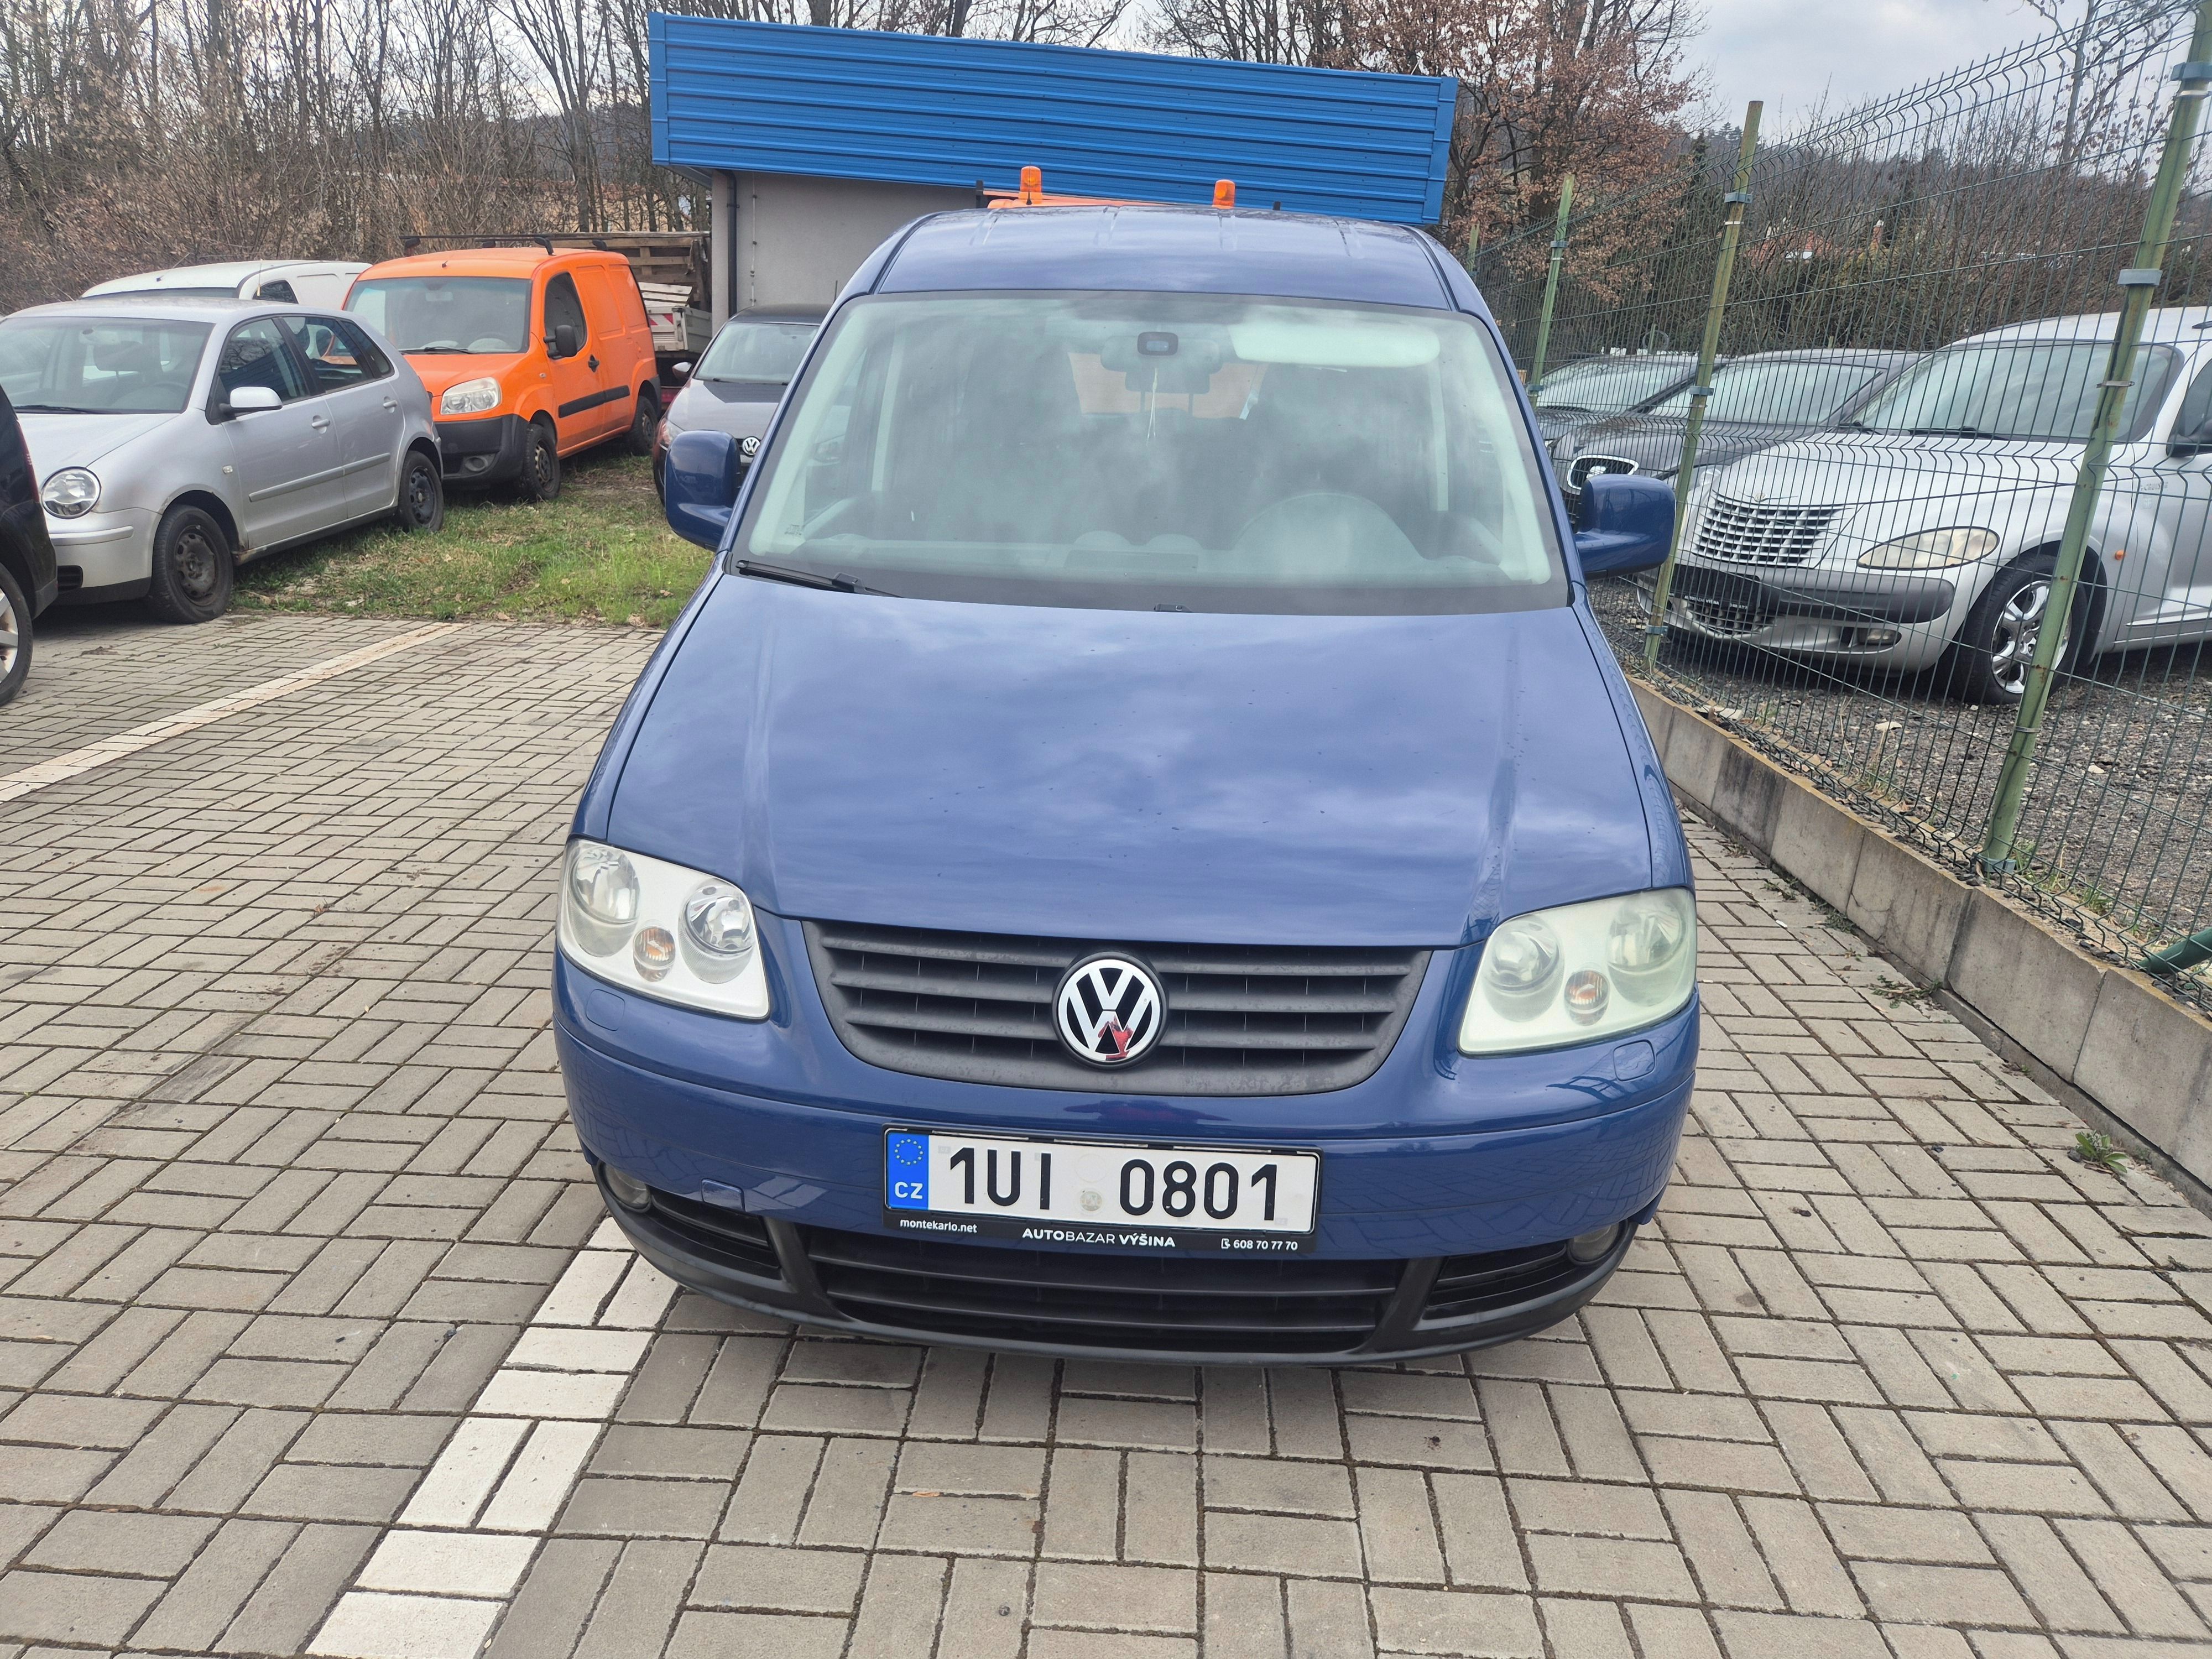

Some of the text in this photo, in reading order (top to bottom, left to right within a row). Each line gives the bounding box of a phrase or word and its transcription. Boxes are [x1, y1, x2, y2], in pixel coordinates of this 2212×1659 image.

[895, 1181, 924, 1199] CZ
[950, 1147, 1277, 1221] 1UI 0801
[900, 1219, 977, 1233] montekarlo.net
[1022, 1228, 1176, 1247] AUTOBAZAR VÝŠINA
[1233, 1239, 1298, 1251] 608 70 77 70
